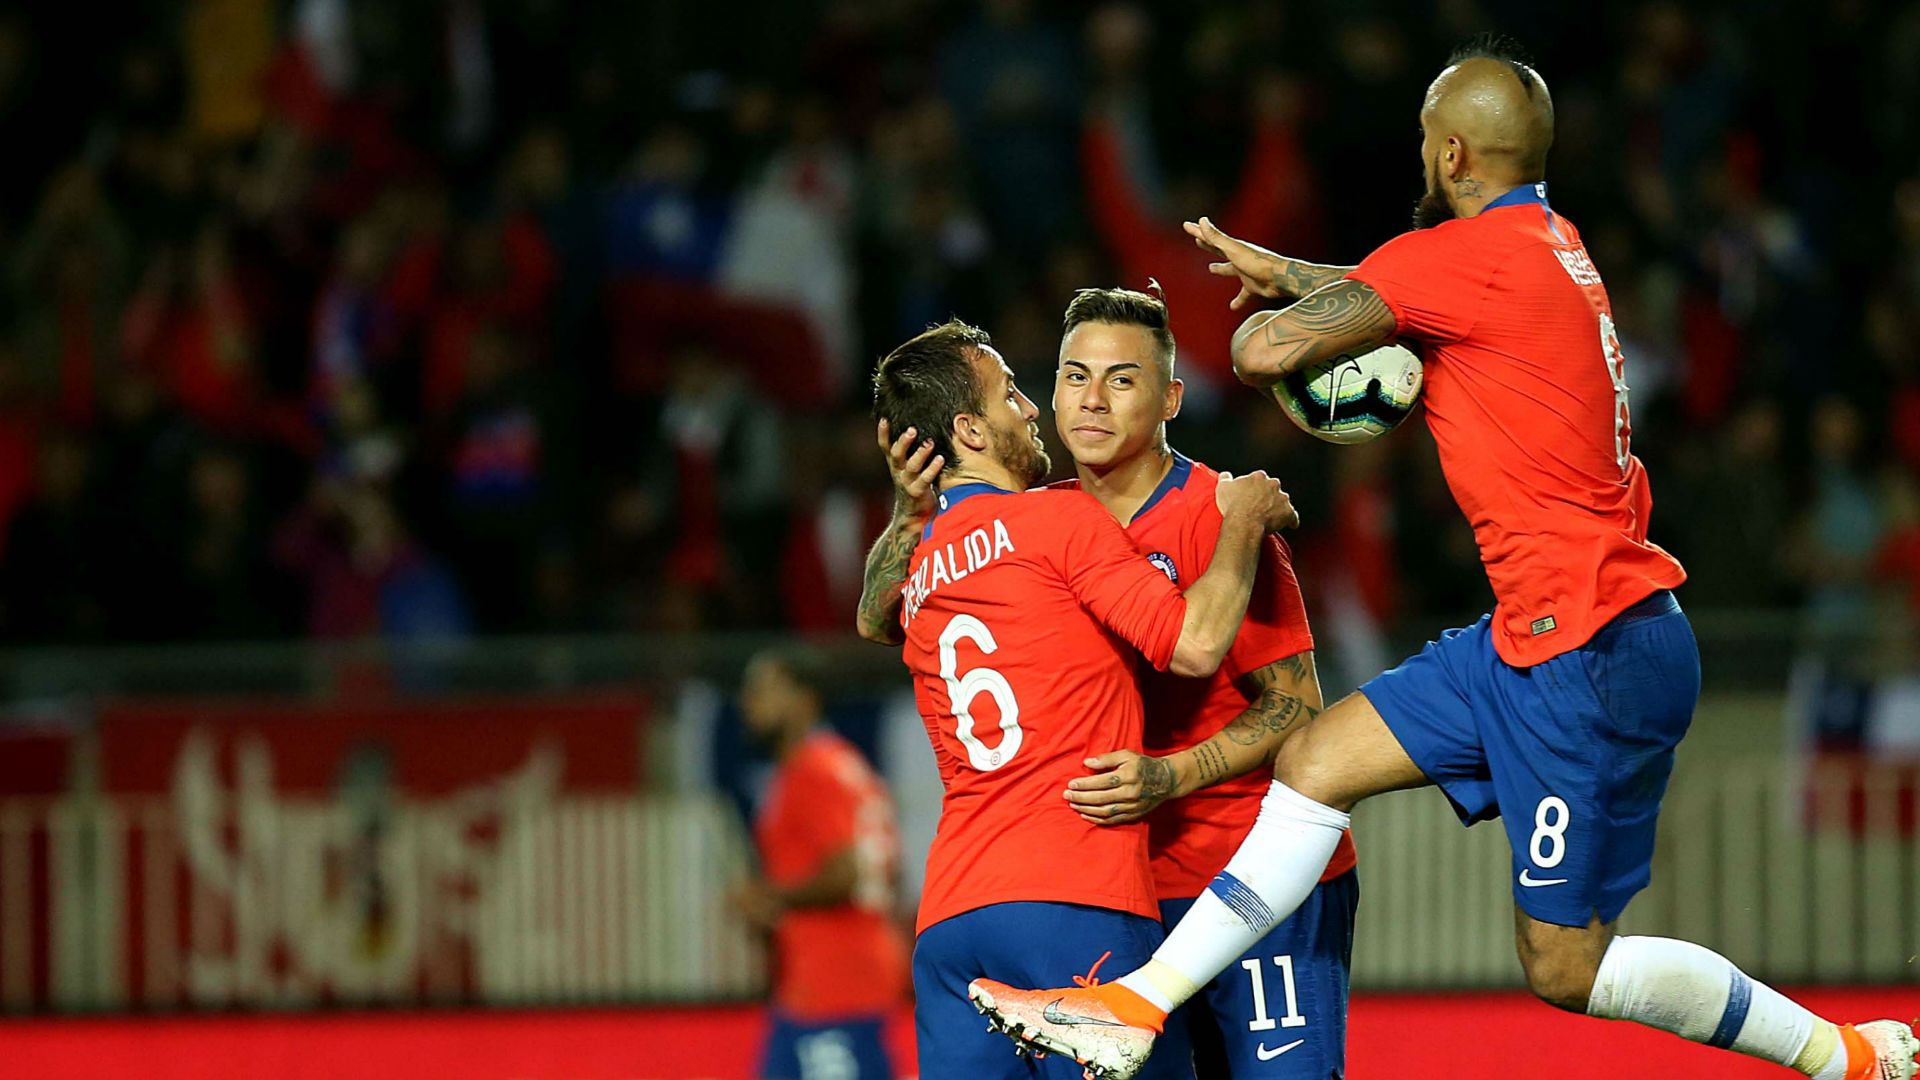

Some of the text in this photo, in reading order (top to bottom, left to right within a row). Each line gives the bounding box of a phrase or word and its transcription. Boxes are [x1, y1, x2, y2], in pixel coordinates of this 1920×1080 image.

[938, 613, 1023, 772] 6
[1529, 795, 1570, 869] 8
[1241, 954, 1306, 1032] 11
